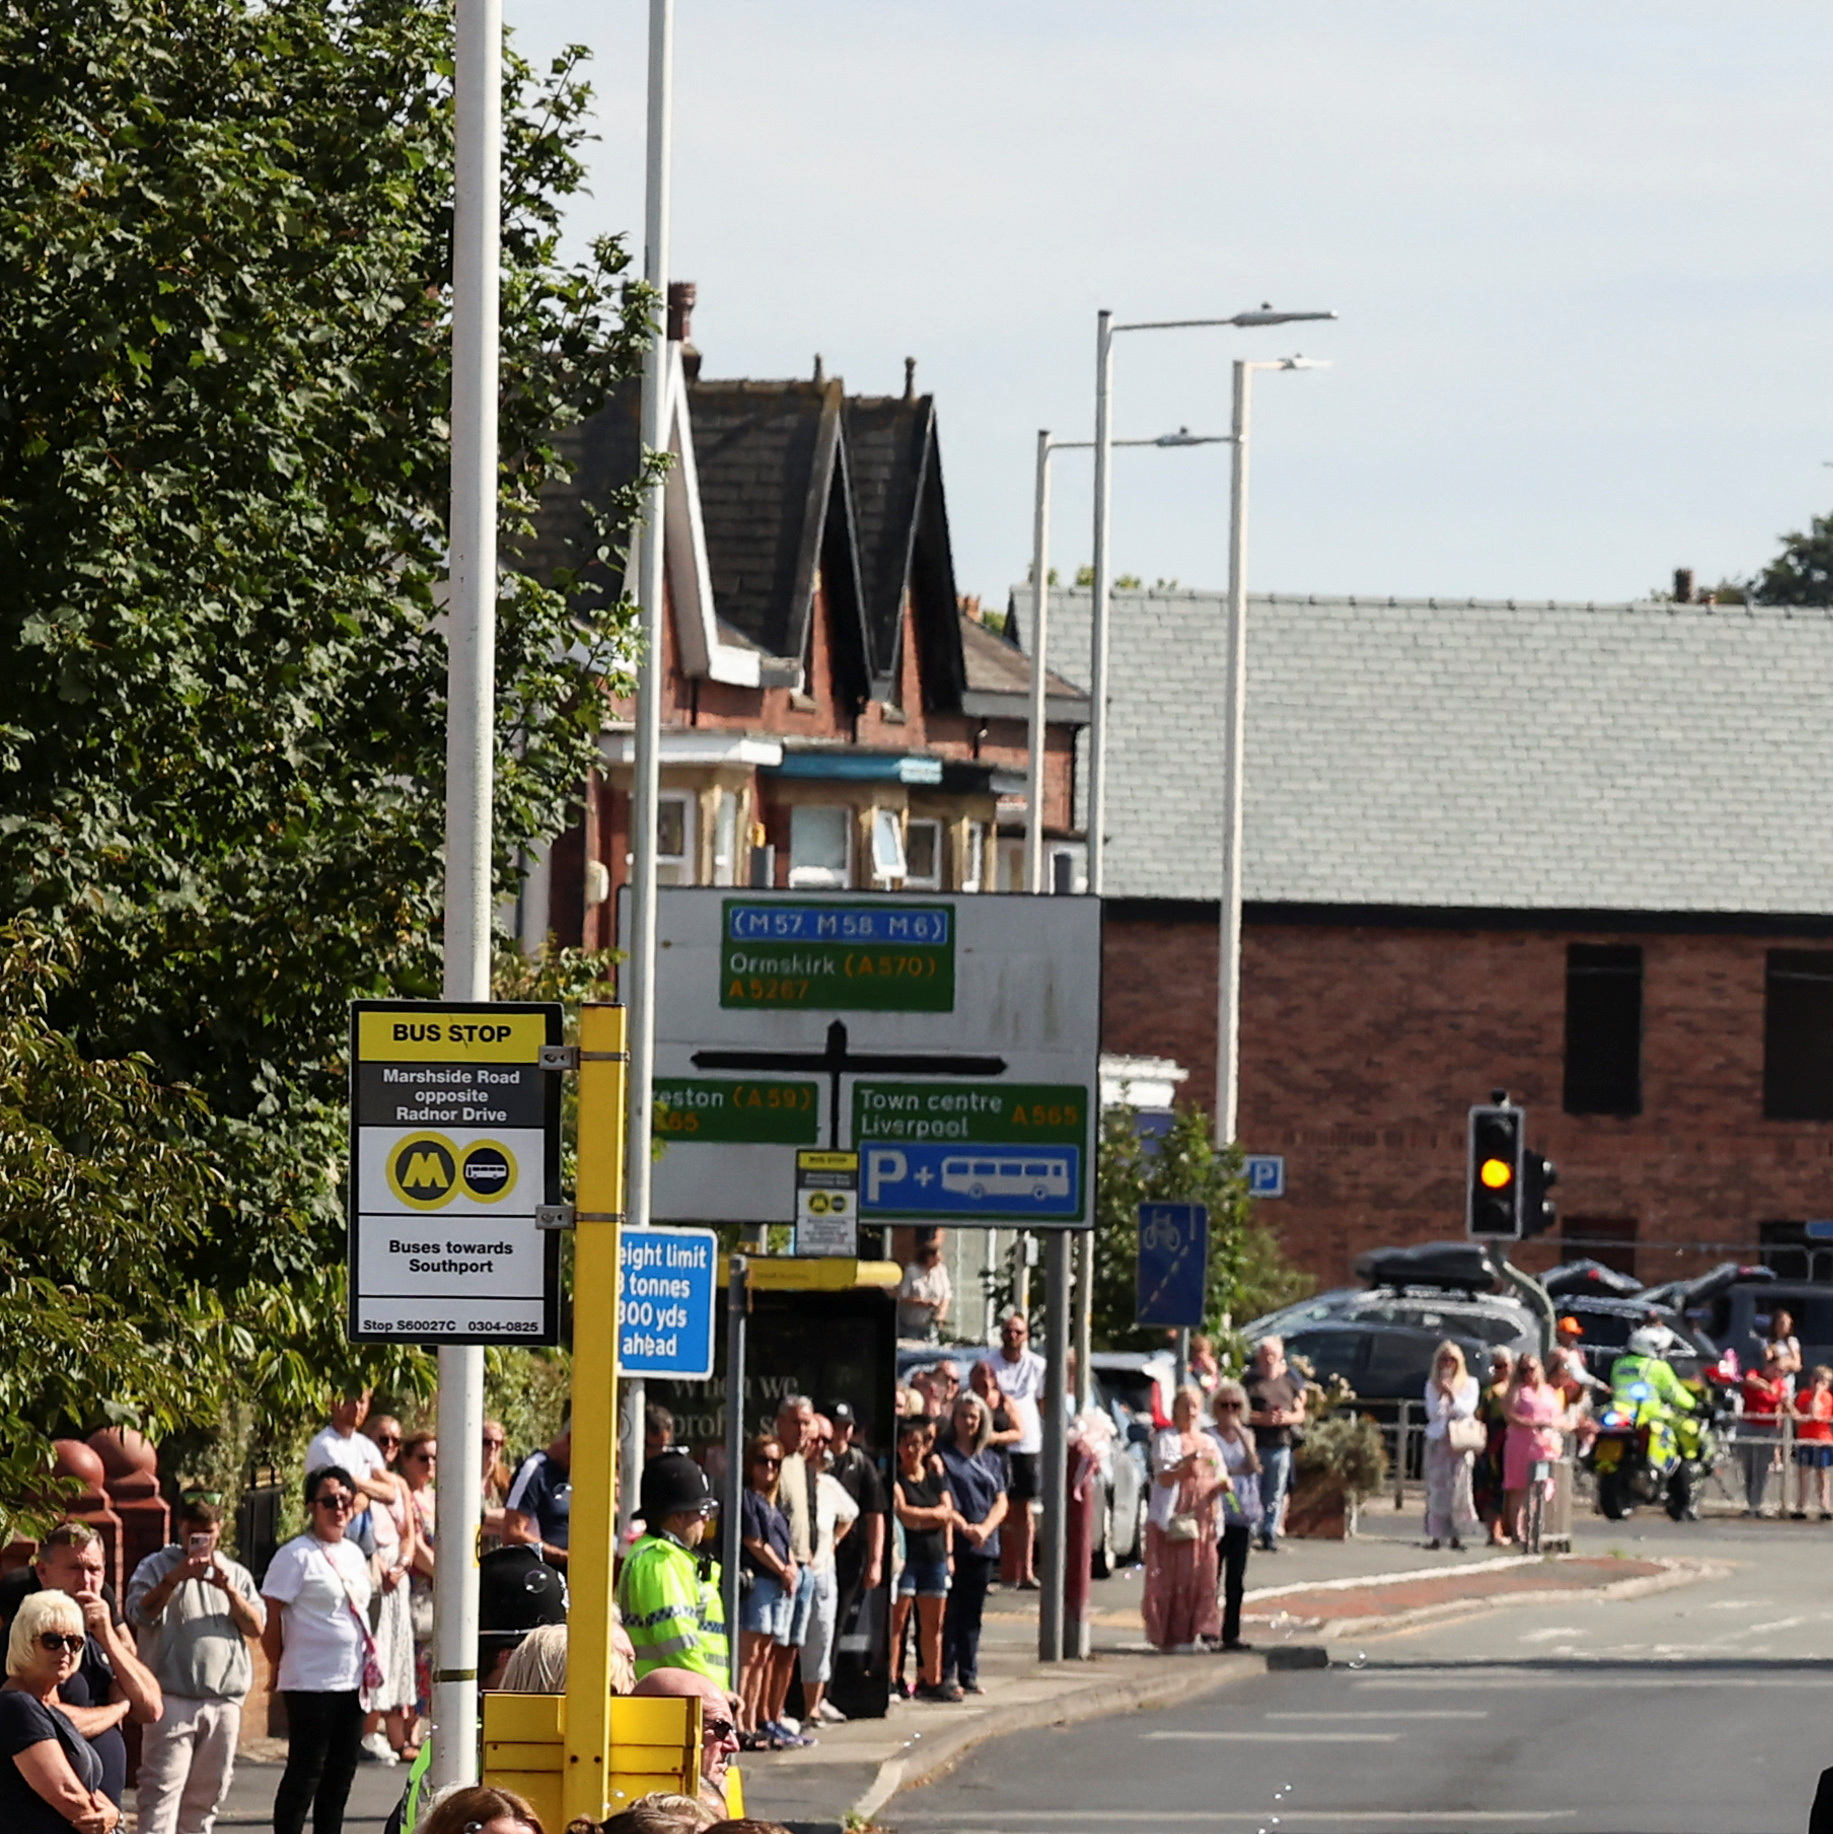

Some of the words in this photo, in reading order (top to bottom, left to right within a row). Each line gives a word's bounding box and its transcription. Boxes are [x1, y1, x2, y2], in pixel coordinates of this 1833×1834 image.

[730, 952, 836, 976] Ormskirk
[393, 1023, 441, 1042] BUS
[449, 1024, 512, 1043] STOP
[383, 1069, 473, 1083] Marshside
[477, 1070, 520, 1084] Road
[414, 1089, 489, 1105] opposite
[860, 1089, 920, 1110] Town
[927, 1090, 1003, 1113] centre
[396, 1106, 458, 1121] Radnor
[462, 1107, 507, 1121] Drive
[861, 1113, 969, 1139] Liverpool
[867, 1149, 908, 1203] P
[1254, 1161, 1275, 1187] P
[389, 1240, 441, 1254] Buses
[446, 1241, 513, 1255] towards
[620, 1241, 662, 1271] eight
[666, 1243, 707, 1269] limit
[409, 1258, 494, 1275] Southport
[629, 1271, 691, 1299] tonnes
[363, 1319, 393, 1333] Stop
[397, 1320, 457, 1331] S60027C
[468, 1321, 539, 1332] 0304-0825
[656, 1303, 688, 1332] yds
[622, 1332, 678, 1357] ahead
